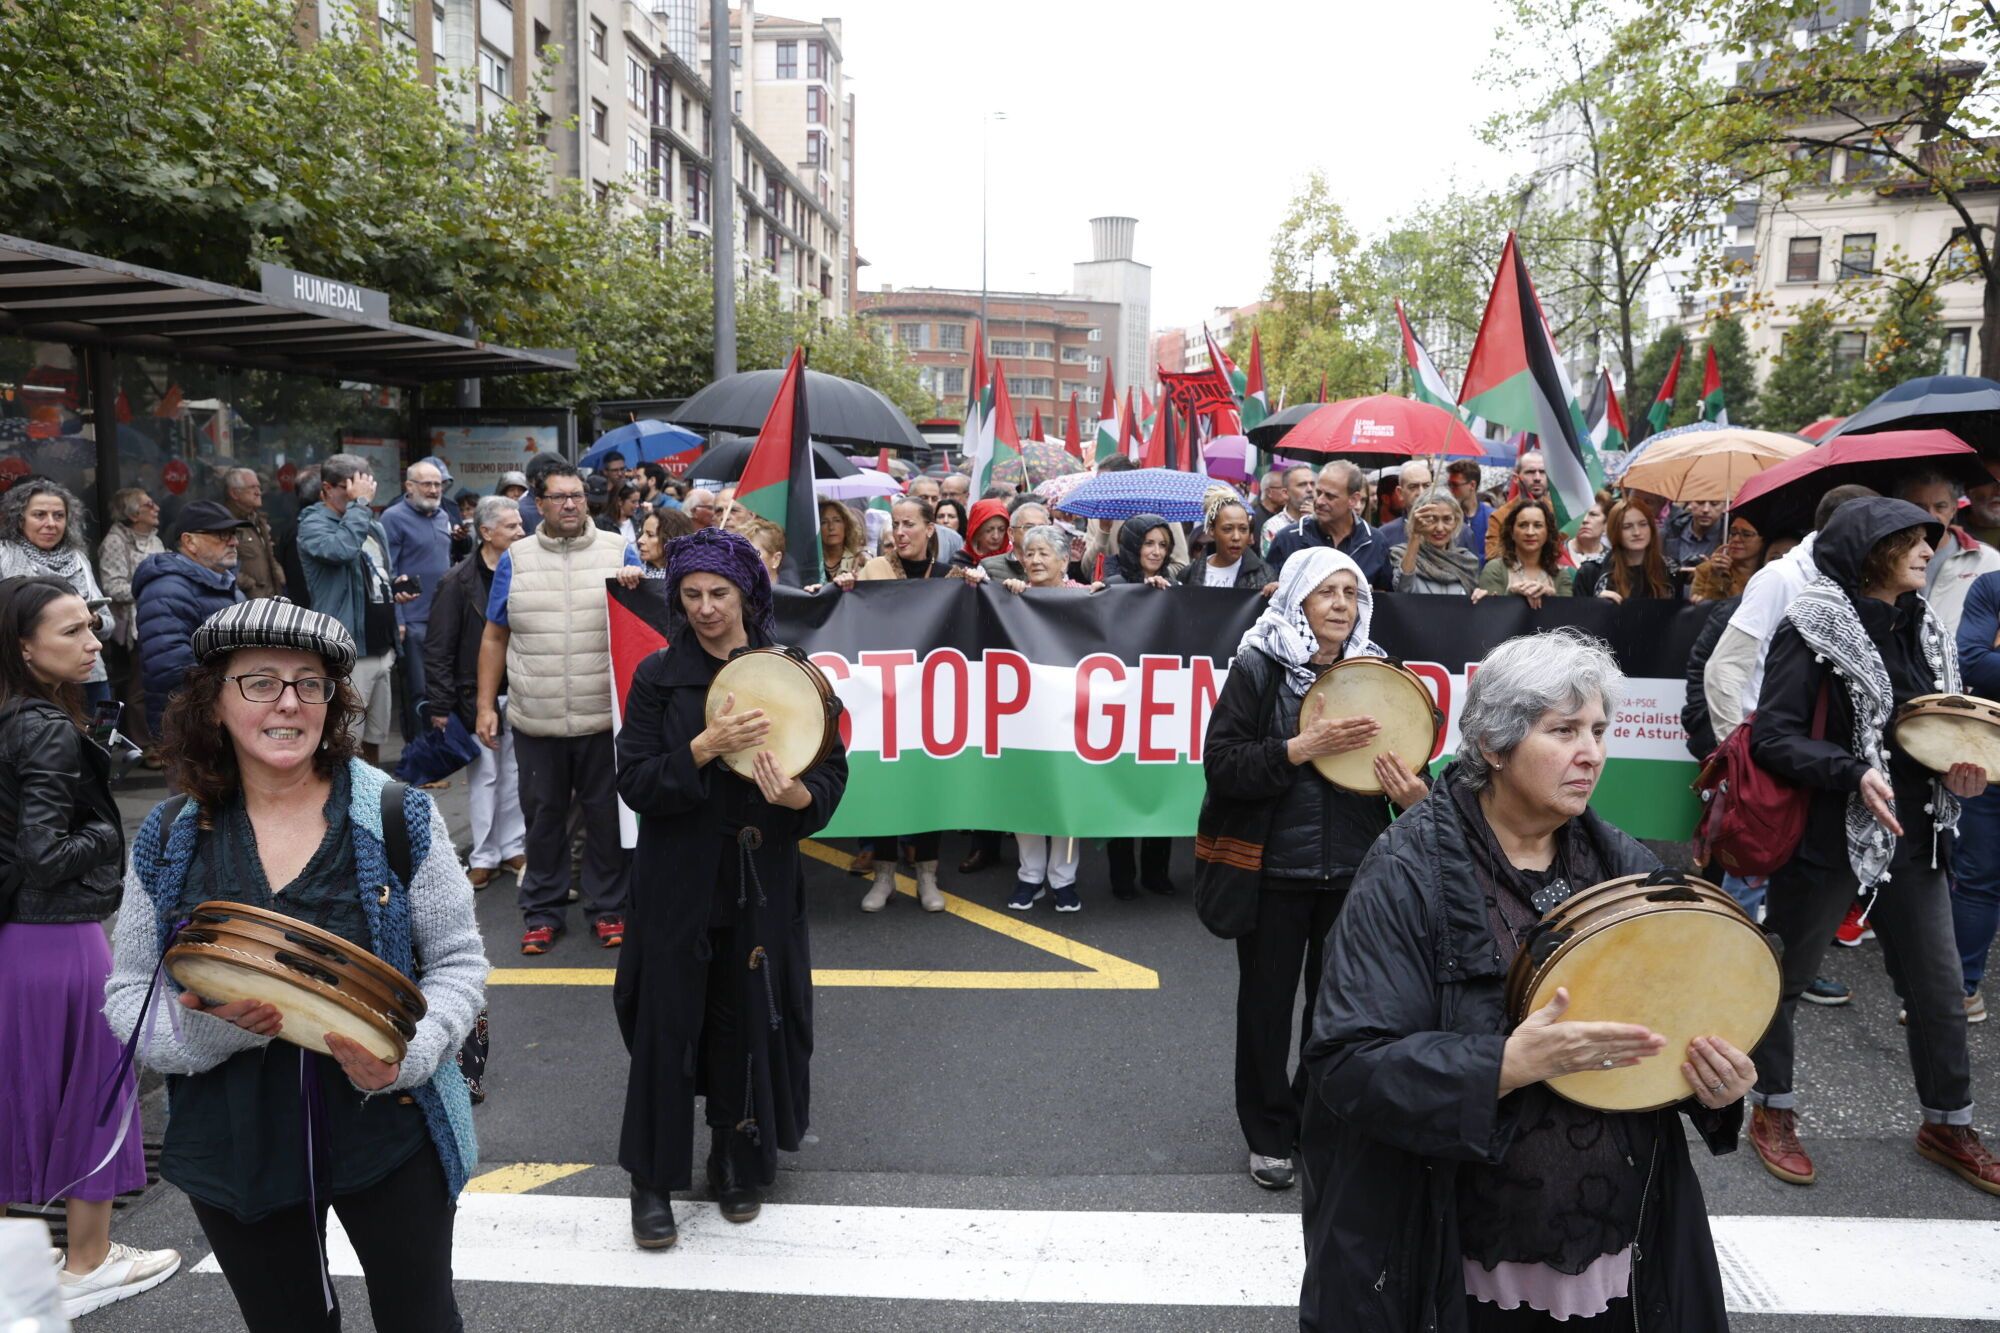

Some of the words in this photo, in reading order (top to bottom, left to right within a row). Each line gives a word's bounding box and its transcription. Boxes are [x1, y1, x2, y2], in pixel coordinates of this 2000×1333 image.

[293, 274, 364, 312] HUMEDAL
[460, 463, 495, 473] TURISMO
[497, 463, 524, 473] RURAL
[807, 650, 1031, 761] STOP
[1615, 712, 1681, 725] Socialist
[1614, 727, 1630, 738] de
[1636, 727, 1692, 740] Asturia
